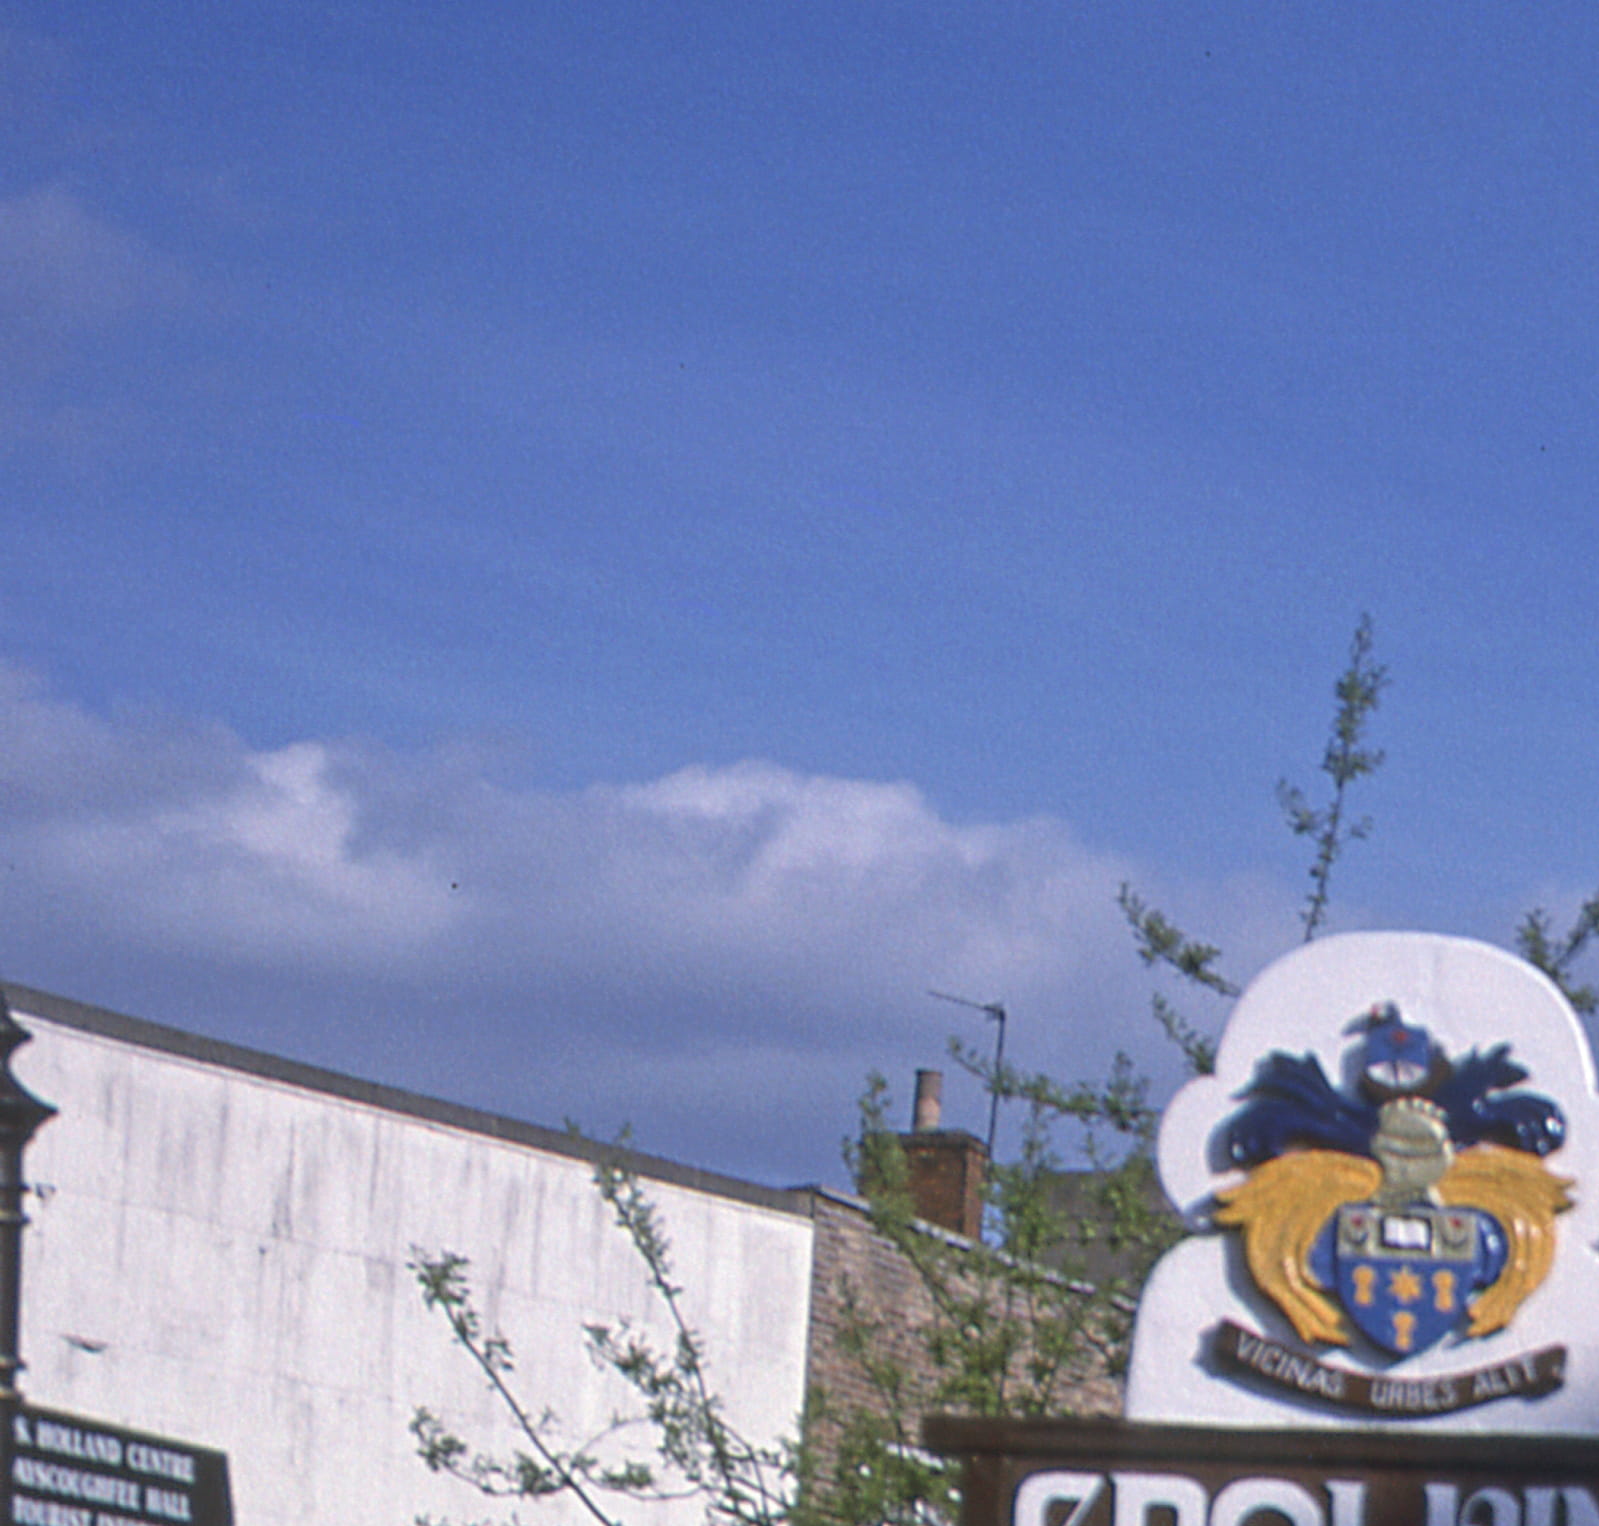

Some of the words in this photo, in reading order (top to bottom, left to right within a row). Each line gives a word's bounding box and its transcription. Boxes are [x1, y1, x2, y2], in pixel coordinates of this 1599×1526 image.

[1236, 1329, 1346, 1398] VICINAS
[1370, 1378, 1456, 1411] URBES
[37, 1420, 123, 1467] HOLLAND
[127, 1441, 197, 1485] CENTRE
[144, 1485, 194, 1522] HALL
